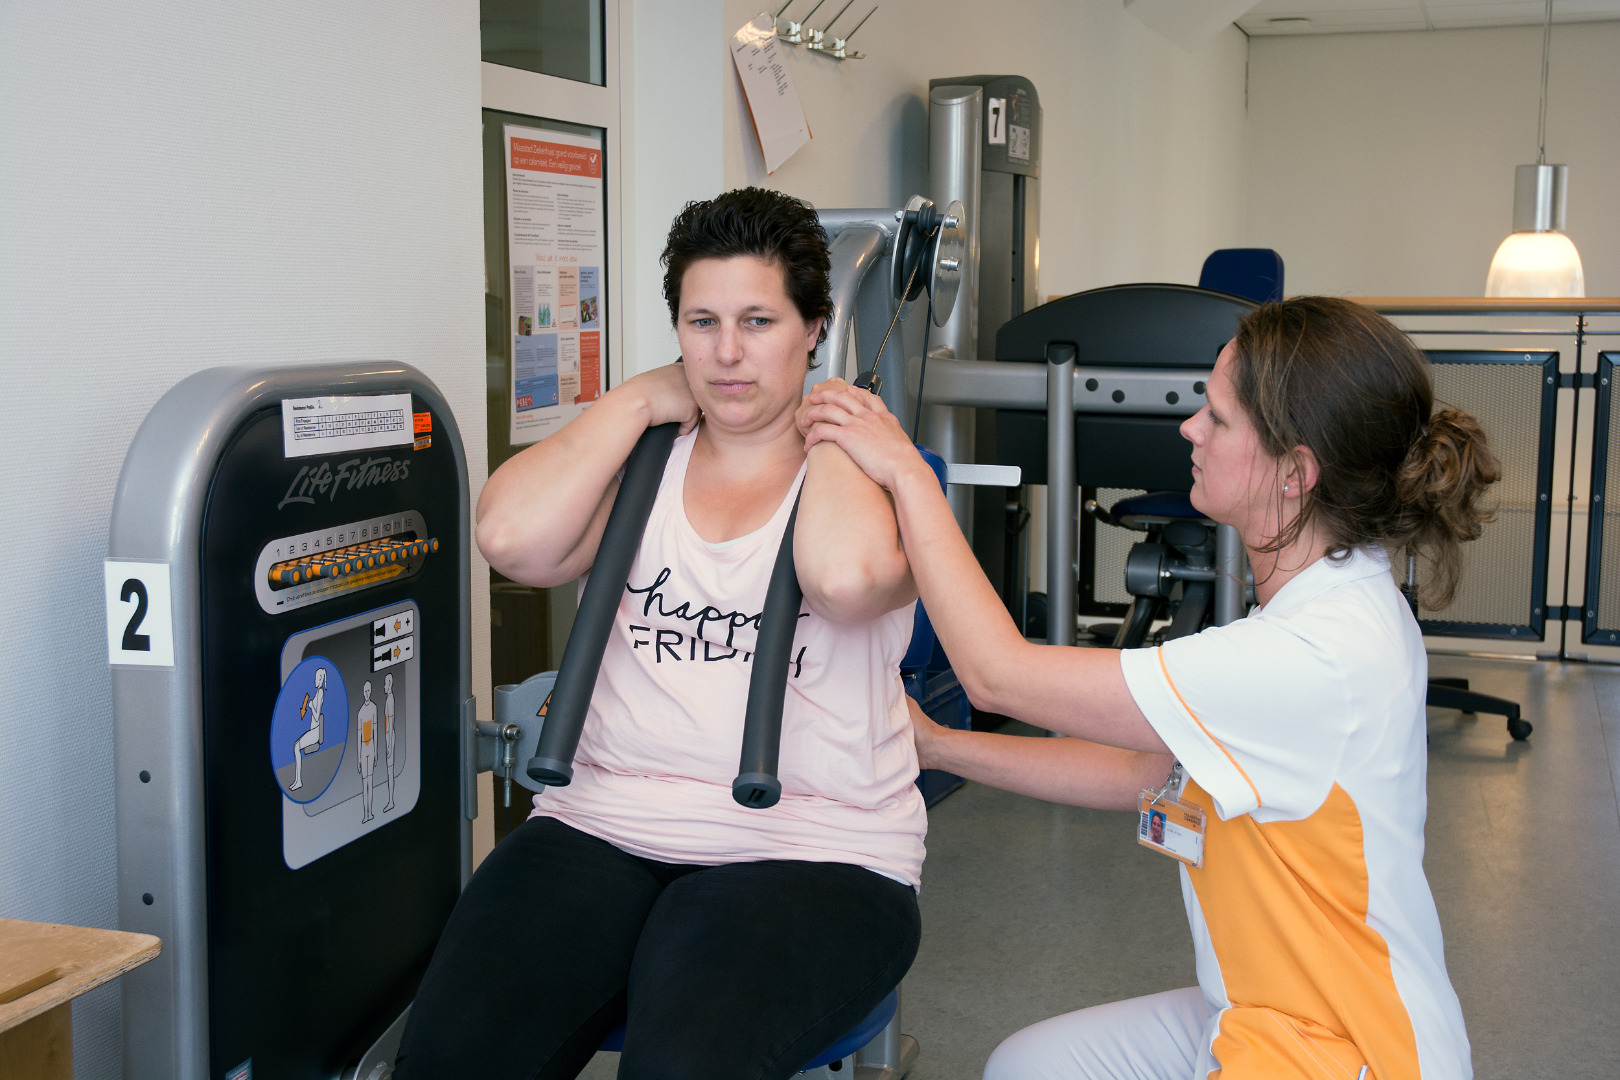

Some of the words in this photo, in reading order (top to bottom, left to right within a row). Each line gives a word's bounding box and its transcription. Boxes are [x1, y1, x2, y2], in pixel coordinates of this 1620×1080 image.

[992, 107, 1000, 138] 7
[277, 462, 332, 511] Life
[330, 456, 411, 503] Fitness
[276, 548, 281, 557] 1
[289, 545, 295, 555] 2
[302, 542, 308, 551] 3
[314, 539, 320, 548] 4
[326, 537, 333, 546] 5
[338, 534, 344, 543] 6
[350, 531, 356, 540] 7
[362, 529, 368, 537] 8
[373, 526, 379, 535] 9
[383, 523, 391, 532] 10
[394, 521, 401, 530] 11
[404, 518, 412, 527] 12
[120, 578, 151, 651] 2
[626, 567, 810, 648] happ
